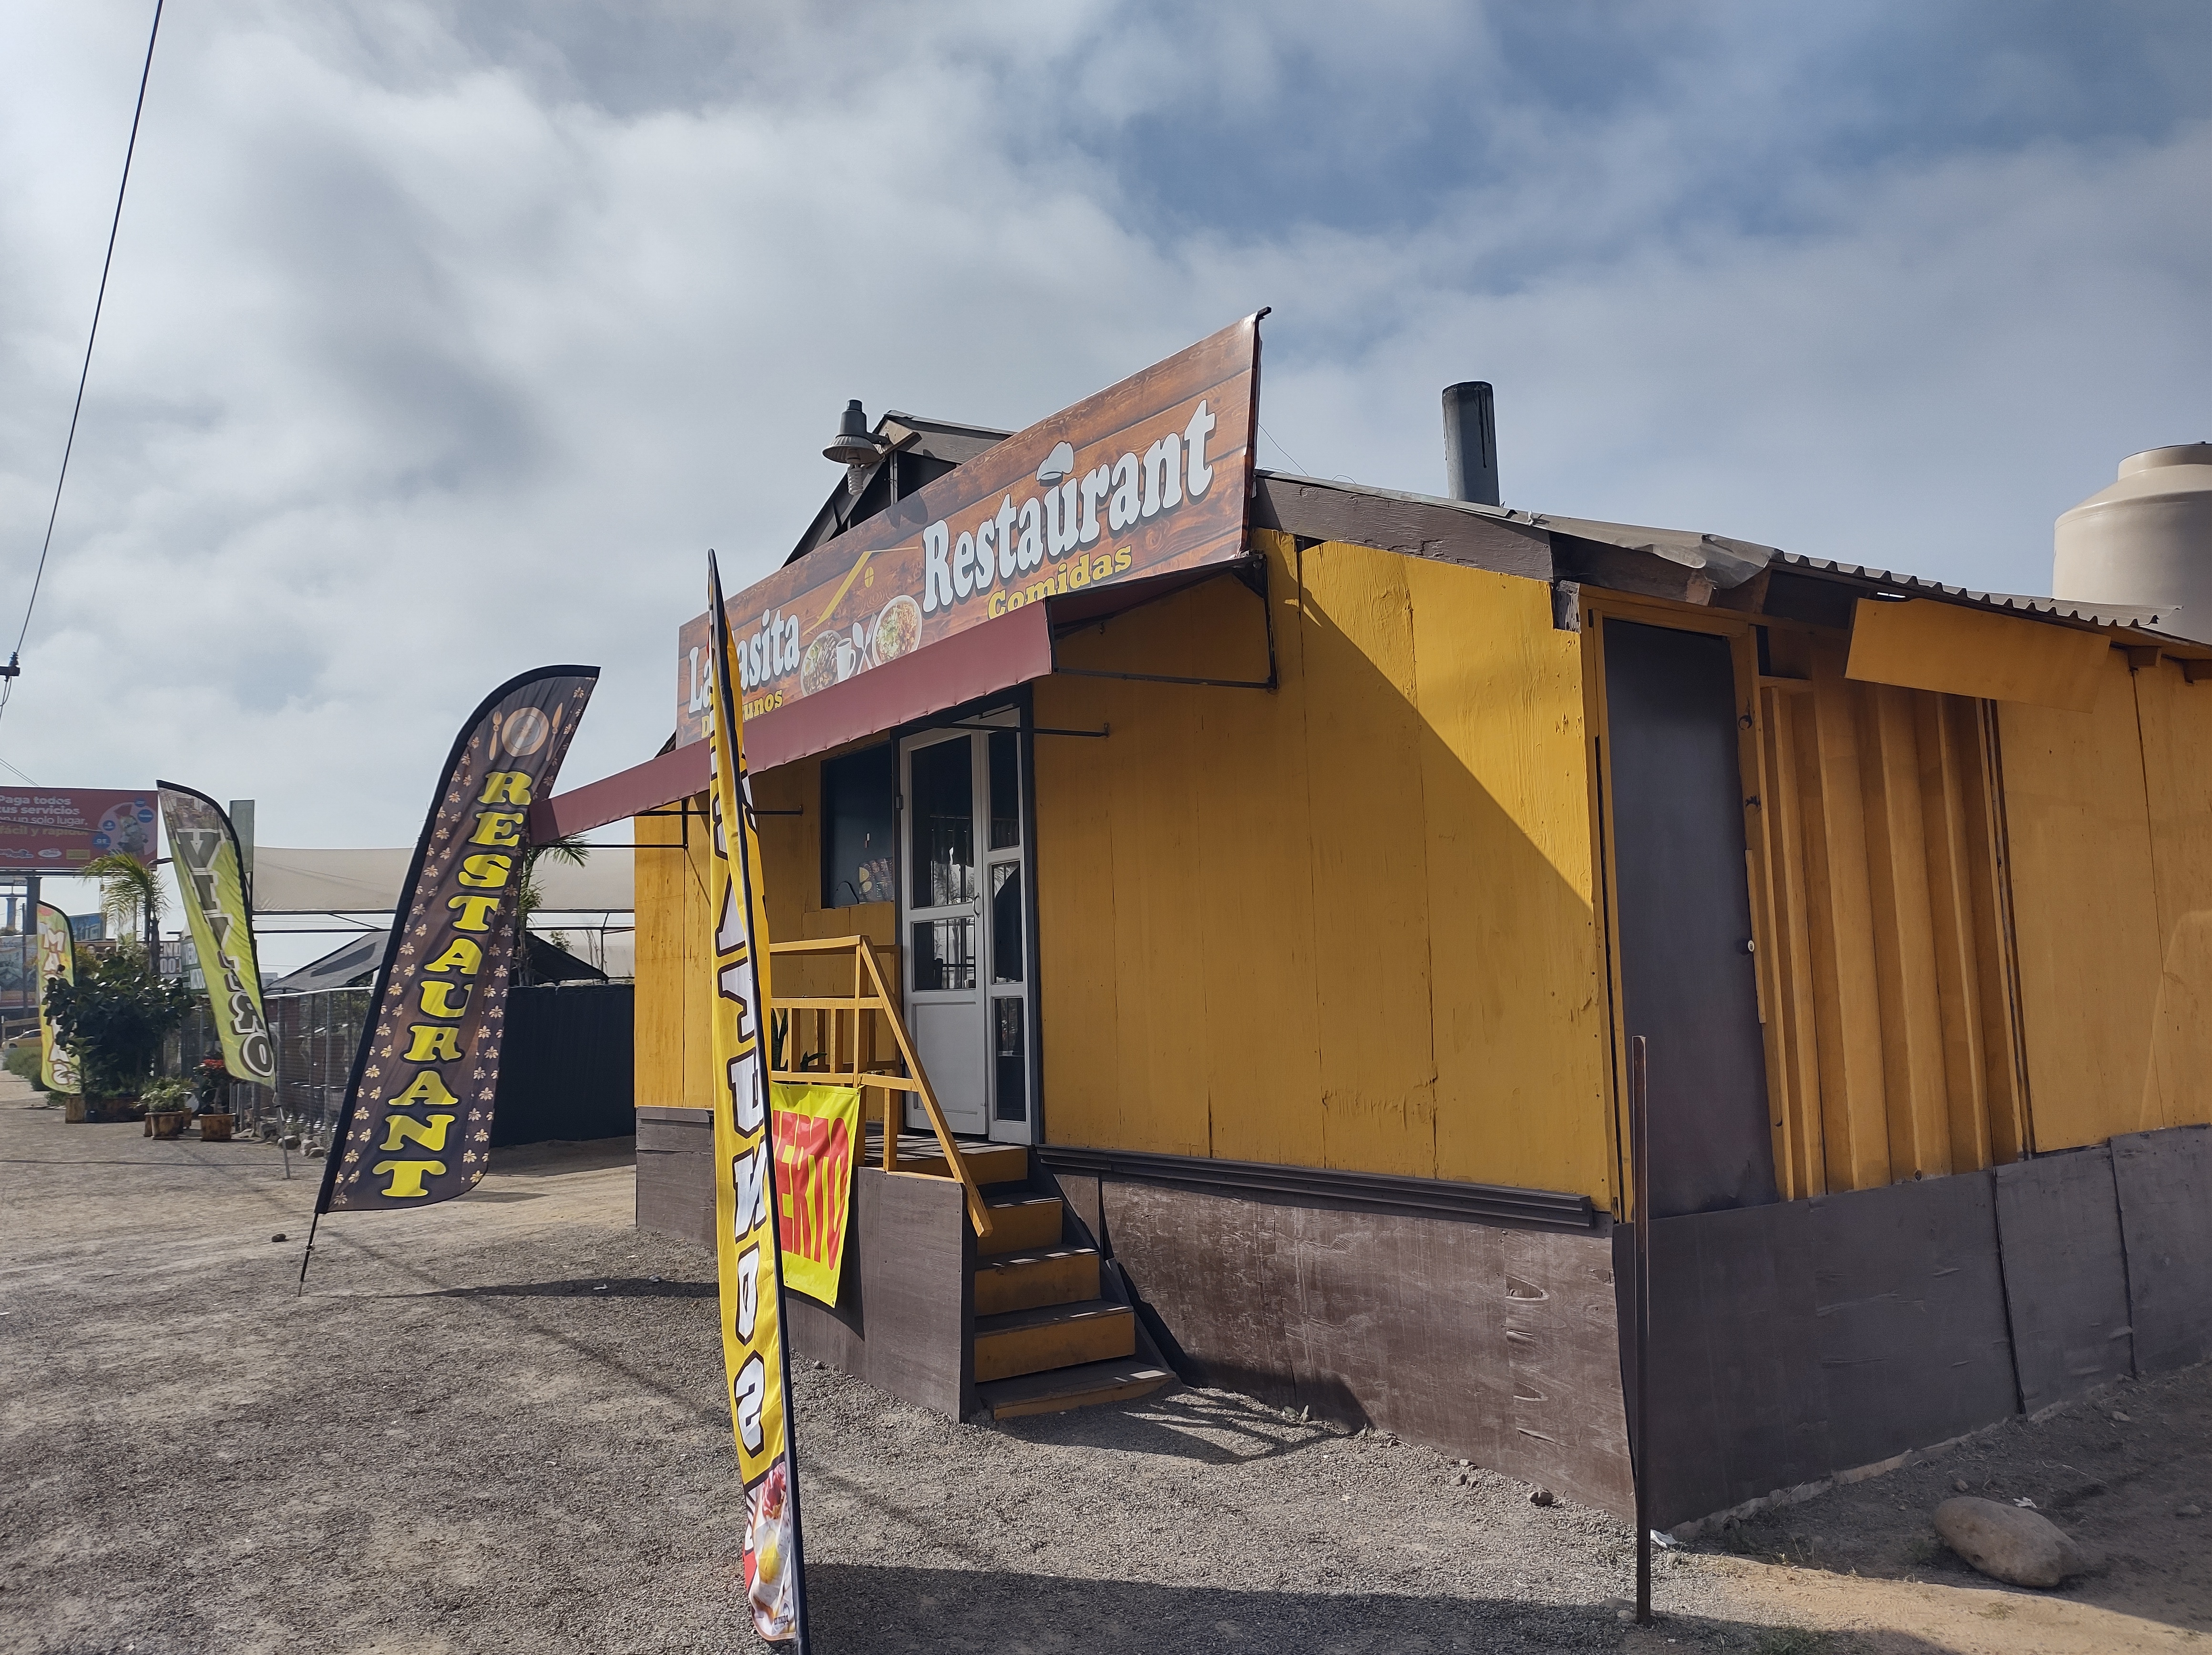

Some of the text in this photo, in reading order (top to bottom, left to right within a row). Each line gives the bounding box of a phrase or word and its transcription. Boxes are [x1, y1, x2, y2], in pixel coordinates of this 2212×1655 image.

[922, 399, 1216, 613] Restaurant
[987, 544, 1132, 620] Comidas
[732, 609, 800, 691] asita
[701, 690, 783, 738] Dunos
[20, 805, 80, 815] servicios
[31, 816, 54, 824] solo
[33, 797, 71, 805] todos
[31, 828, 39, 837] y
[372, 769, 532, 1198] RESTAURANT
